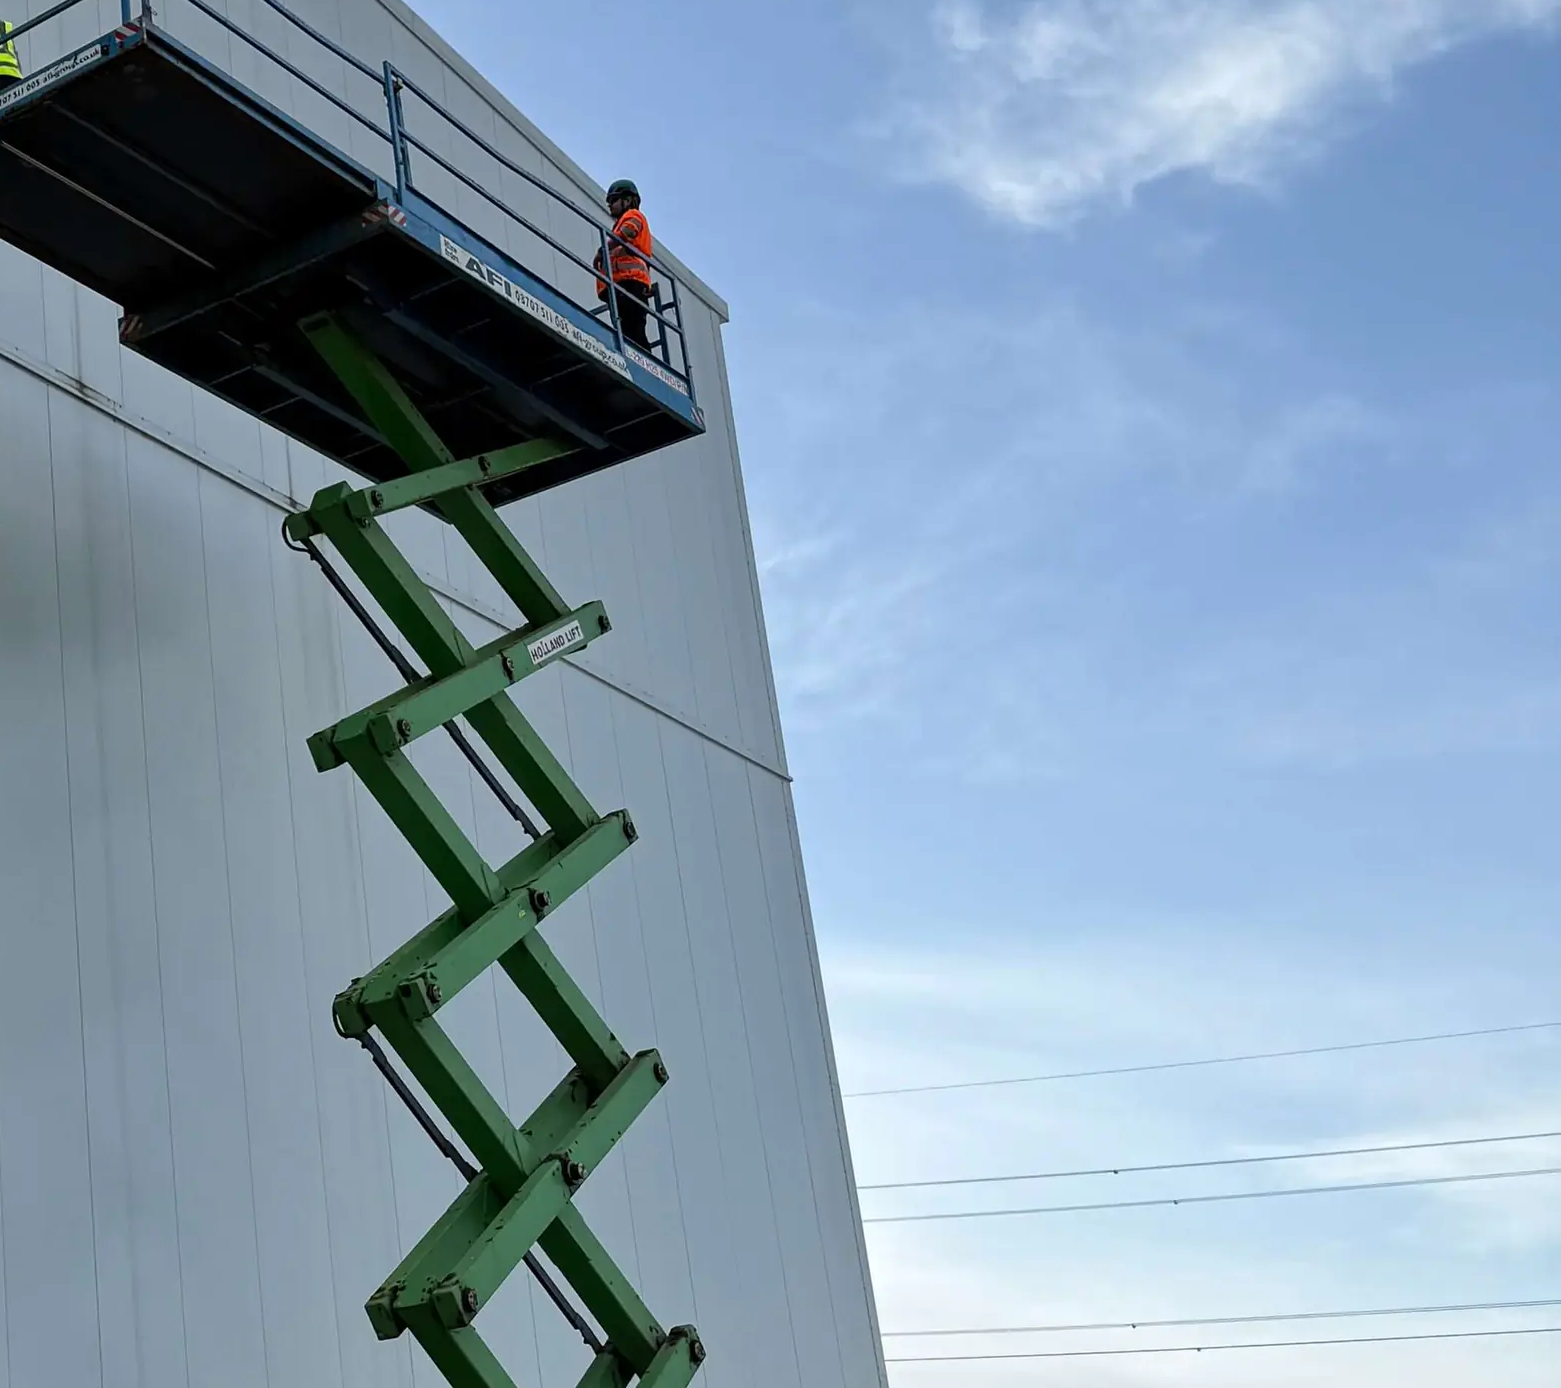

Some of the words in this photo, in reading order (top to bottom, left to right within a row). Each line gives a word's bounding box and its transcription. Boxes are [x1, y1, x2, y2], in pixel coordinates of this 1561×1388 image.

[465, 256, 512, 298] AFI
[541, 305, 553, 323] 511
[530, 634, 565, 661] HOLLAND
[565, 625, 583, 643] LIFT
